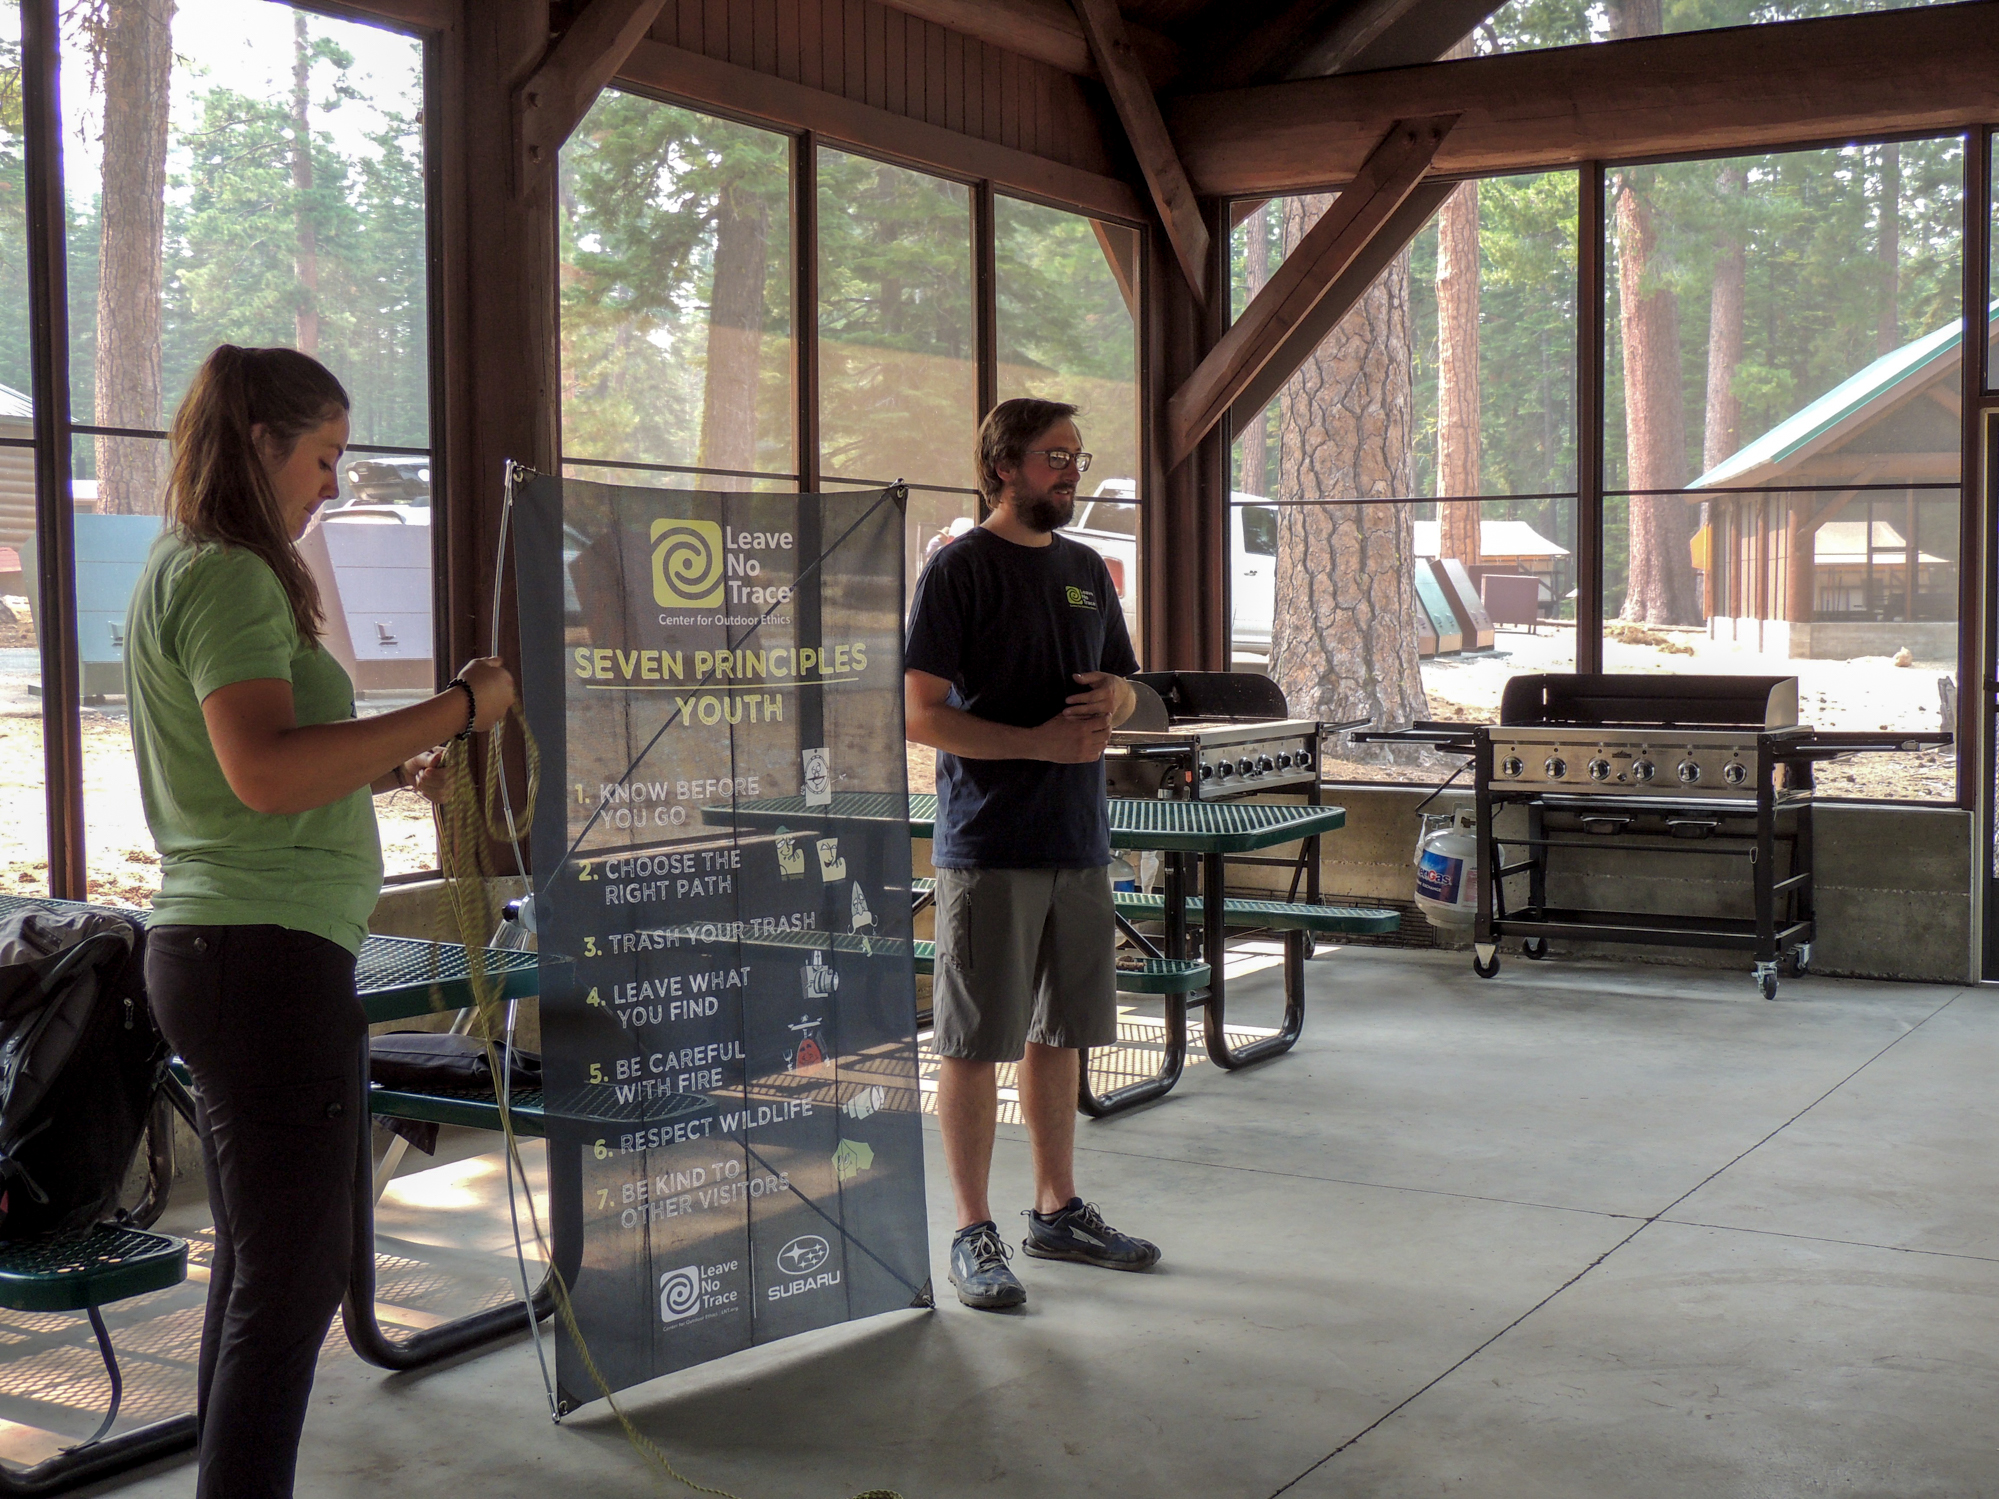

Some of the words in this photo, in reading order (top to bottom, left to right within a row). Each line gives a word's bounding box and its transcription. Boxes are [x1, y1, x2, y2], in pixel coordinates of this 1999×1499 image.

[726, 525, 793, 550] Leave
[727, 553, 760, 577] No
[728, 580, 792, 604] Trace
[658, 613, 694, 626] Center
[696, 613, 712, 626] for
[714, 613, 759, 626] Outdoor
[760, 613, 791, 626] Ethics
[574, 647, 684, 679] SEVEN
[695, 642, 868, 679] PRINCIPLES
[675, 694, 783, 726] YOUTH
[575, 784, 590, 803] 1.
[599, 781, 668, 803] KNOW
[676, 776, 760, 800] BEFORE
[600, 808, 647, 829] YOU
[654, 805, 686, 826] GO
[578, 861, 598, 881] 2.
[605, 853, 695, 880] CHOOSE
[702, 849, 741, 872] THE
[605, 880, 670, 905] RIGHT
[677, 875, 732, 898] PATH
[583, 936, 602, 957] 3.
[609, 928, 680, 954] TRASH
[687, 921, 744, 946] YOUR
[750, 911, 816, 939] TRASH
[586, 986, 606, 1007] 4.
[613, 976, 682, 1005] LEAVE
[689, 966, 751, 993] WHAT
[617, 1004, 663, 1029] YOU
[670, 996, 718, 1021] FIND
[589, 1063, 609, 1084] 5.
[616, 1056, 642, 1080] BE
[649, 1040, 746, 1074] CAREFUL
[615, 1076, 671, 1105] WITH
[678, 1068, 723, 1093] FIRE
[593, 1139, 613, 1160] 6.
[620, 1117, 713, 1155] RESPECT
[719, 1098, 813, 1134] WILDLIFE
[596, 1188, 614, 1210] 7.
[622, 1179, 648, 1204] BE
[655, 1166, 706, 1196] KIND
[711, 1160, 740, 1181] TO
[620, 1194, 692, 1229] OTHER
[699, 1171, 790, 1210] VISITORS
[700, 1260, 738, 1278] Leave
[701, 1279, 720, 1294] No
[702, 1290, 738, 1309] Trace
[767, 1270, 841, 1301] SUBARU
[662, 1323, 678, 1332] Center
